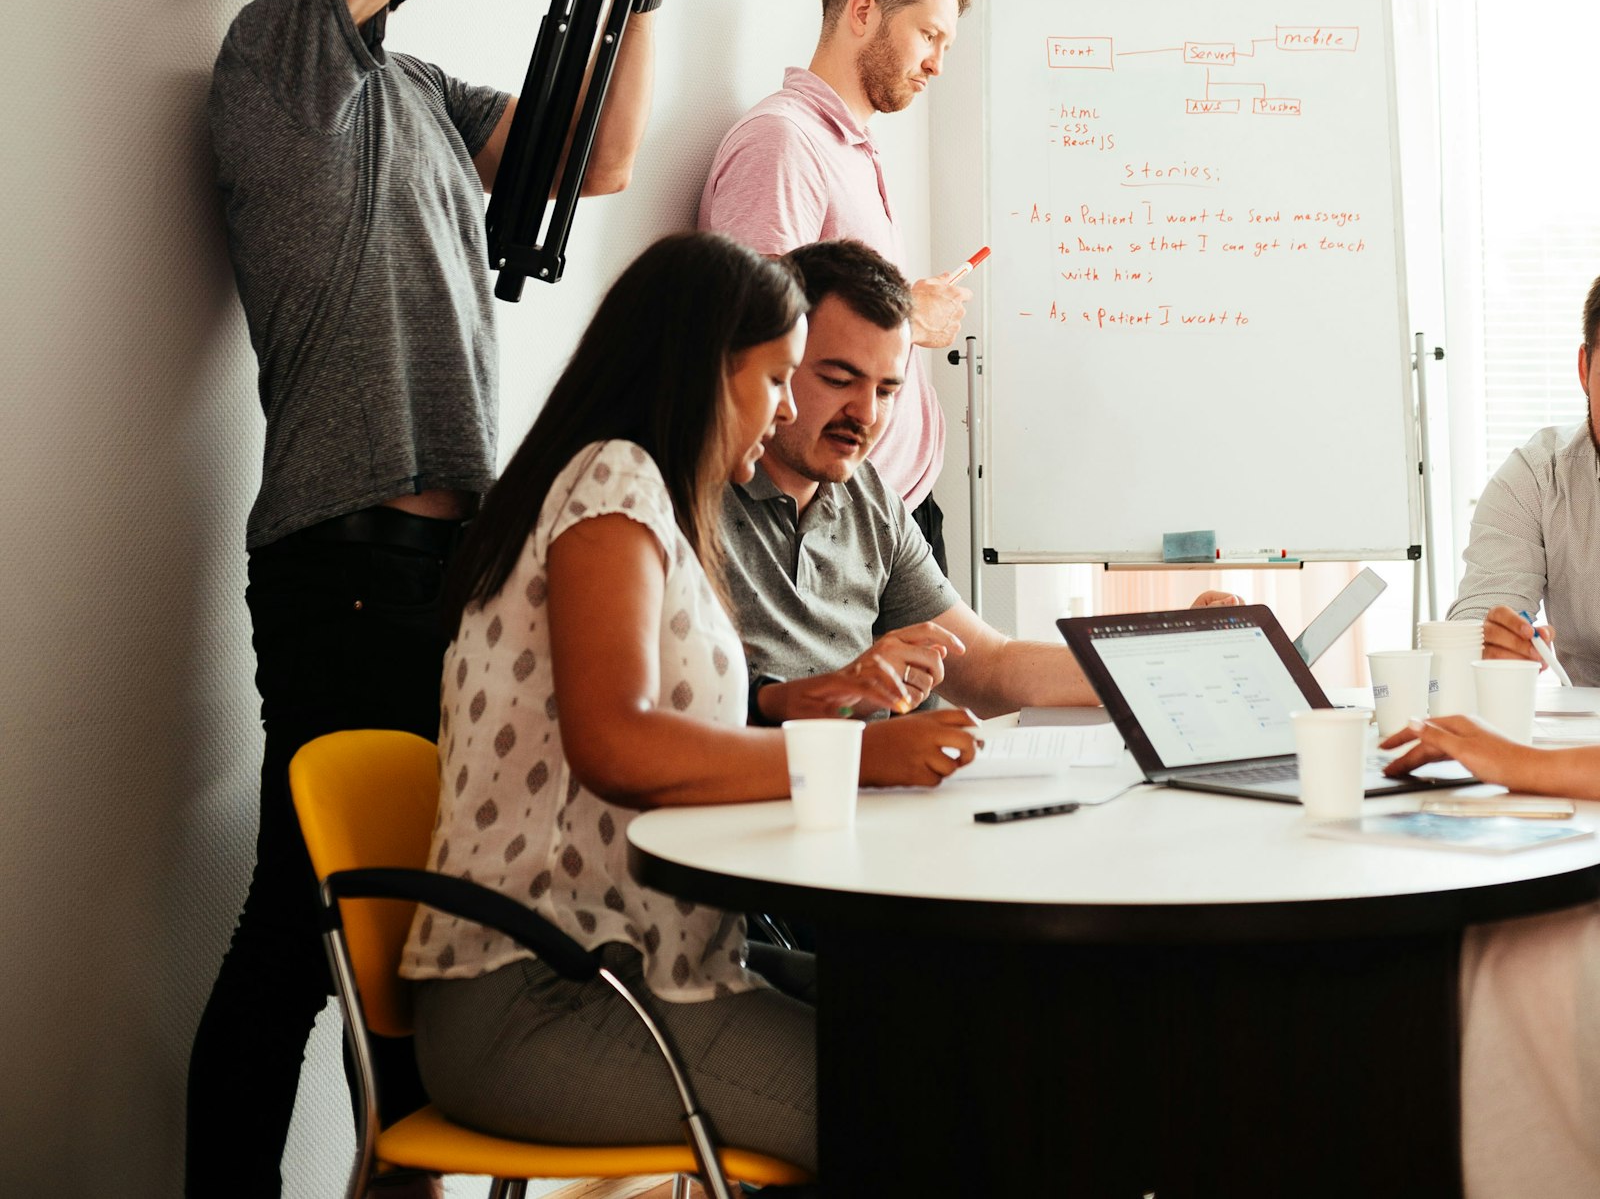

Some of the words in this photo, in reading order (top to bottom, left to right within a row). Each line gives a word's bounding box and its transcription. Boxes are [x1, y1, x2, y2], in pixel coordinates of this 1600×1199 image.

[1054, 44, 1094, 56] Front
[1190, 45, 1235, 61] Server
[1030, 203, 1052, 224] As
[1063, 214, 1073, 225] a
[1141, 200, 1154, 225] I
[1165, 208, 1209, 224] want
[1215, 209, 1234, 224] to
[1293, 210, 1362, 227] messages
[1058, 241, 1070, 254] to
[1077, 237, 1113, 253] Doctor
[1129, 241, 1142, 254] so
[1149, 236, 1188, 251] that
[1197, 234, 1209, 252] I
[1221, 242, 1245, 252] can
[1253, 239, 1281, 257] get
[1289, 237, 1306, 251] in
[1318, 236, 1366, 252] touch
[1060, 267, 1101, 282] with
[1049, 300, 1068, 324] As
[1082, 310, 1092, 324] a
[1157, 304, 1173, 326] I
[1181, 310, 1229, 325] want
[1233, 310, 1250, 325] to
